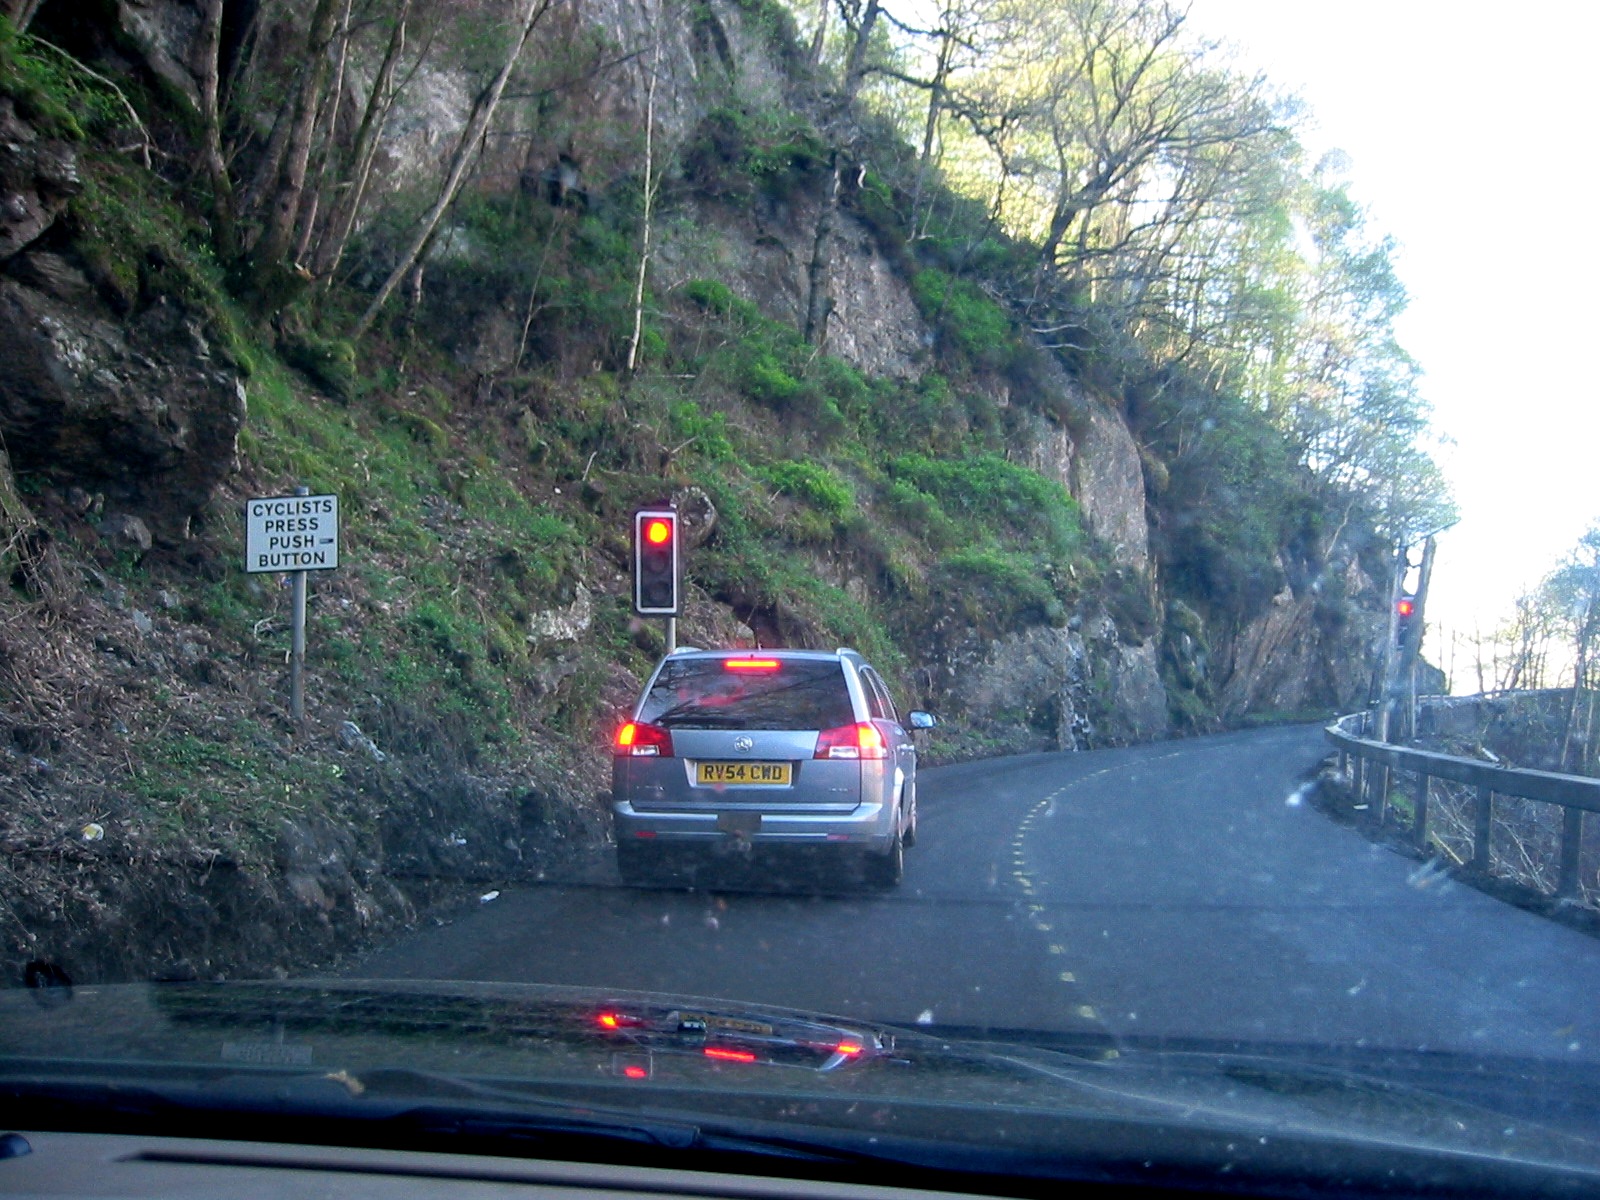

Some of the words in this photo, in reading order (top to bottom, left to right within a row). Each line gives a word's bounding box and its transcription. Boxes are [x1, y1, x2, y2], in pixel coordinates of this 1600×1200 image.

[253, 500, 332, 517] CYCLISTS
[265, 517, 319, 533] PRESS
[269, 535, 314, 550] PUSH
[259, 551, 325, 567] BUTTON
[704, 764, 746, 780] RV54
[750, 764, 782, 780] CWD
